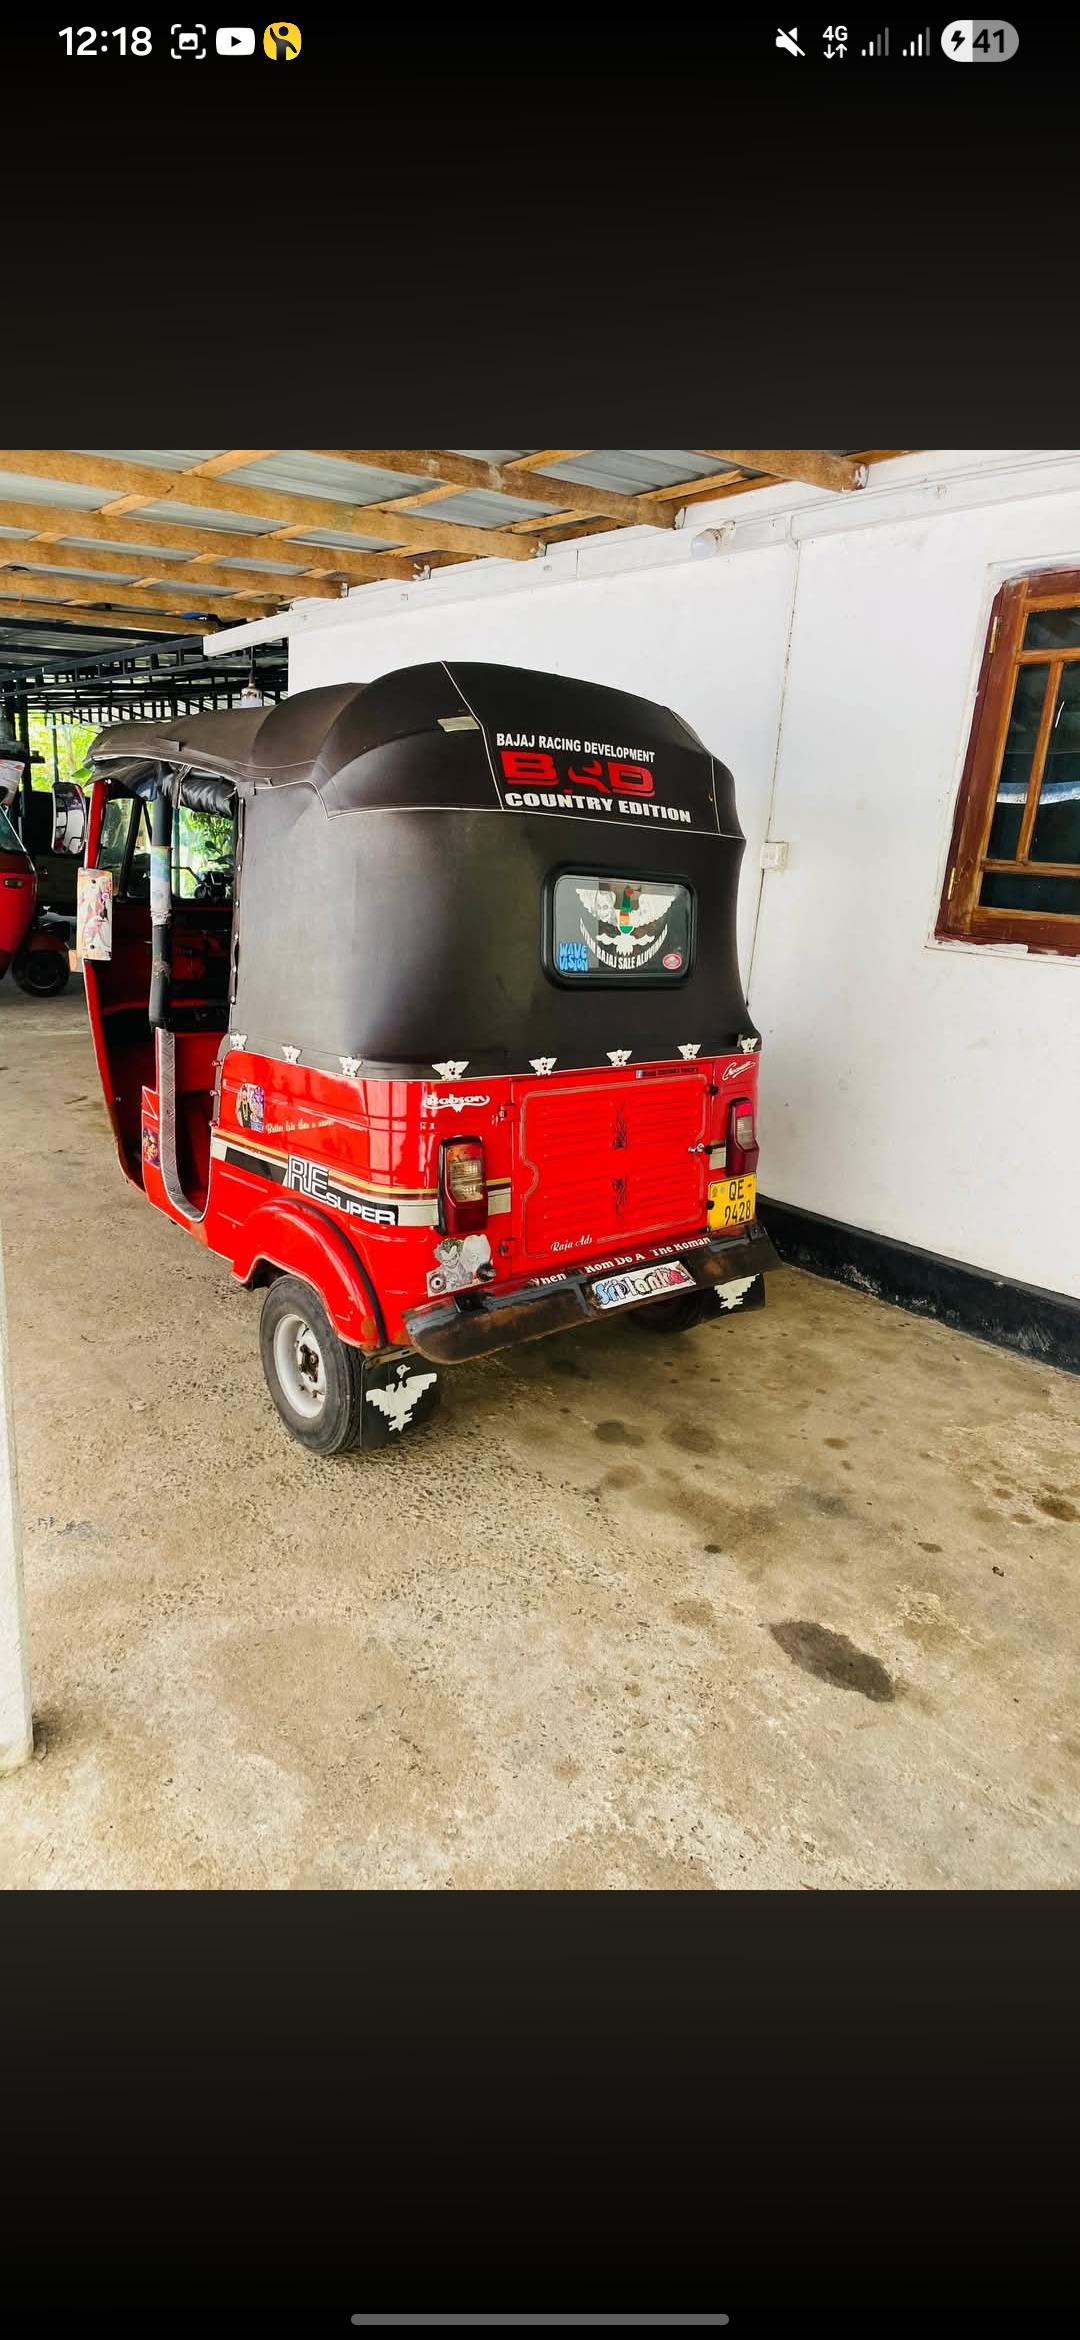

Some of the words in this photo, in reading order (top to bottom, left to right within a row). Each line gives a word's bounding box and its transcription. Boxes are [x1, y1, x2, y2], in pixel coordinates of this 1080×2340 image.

[496, 733, 535, 747] BAJAJ
[538, 735, 582, 752] RACING
[584, 741, 655, 763] DEVELOPMENT
[505, 792, 613, 812] COUNTRY
[618, 800, 691, 823] EDITION
[559, 943, 587, 959] WAVE
[596, 944, 617, 968] BAJAJ
[618, 956, 635, 970] SALE
[326, 1192, 396, 1226] SUPER
[724, 1200, 751, 1227] 9428
[635, 1253, 646, 1261] A
[650, 1245, 673, 1257] The
